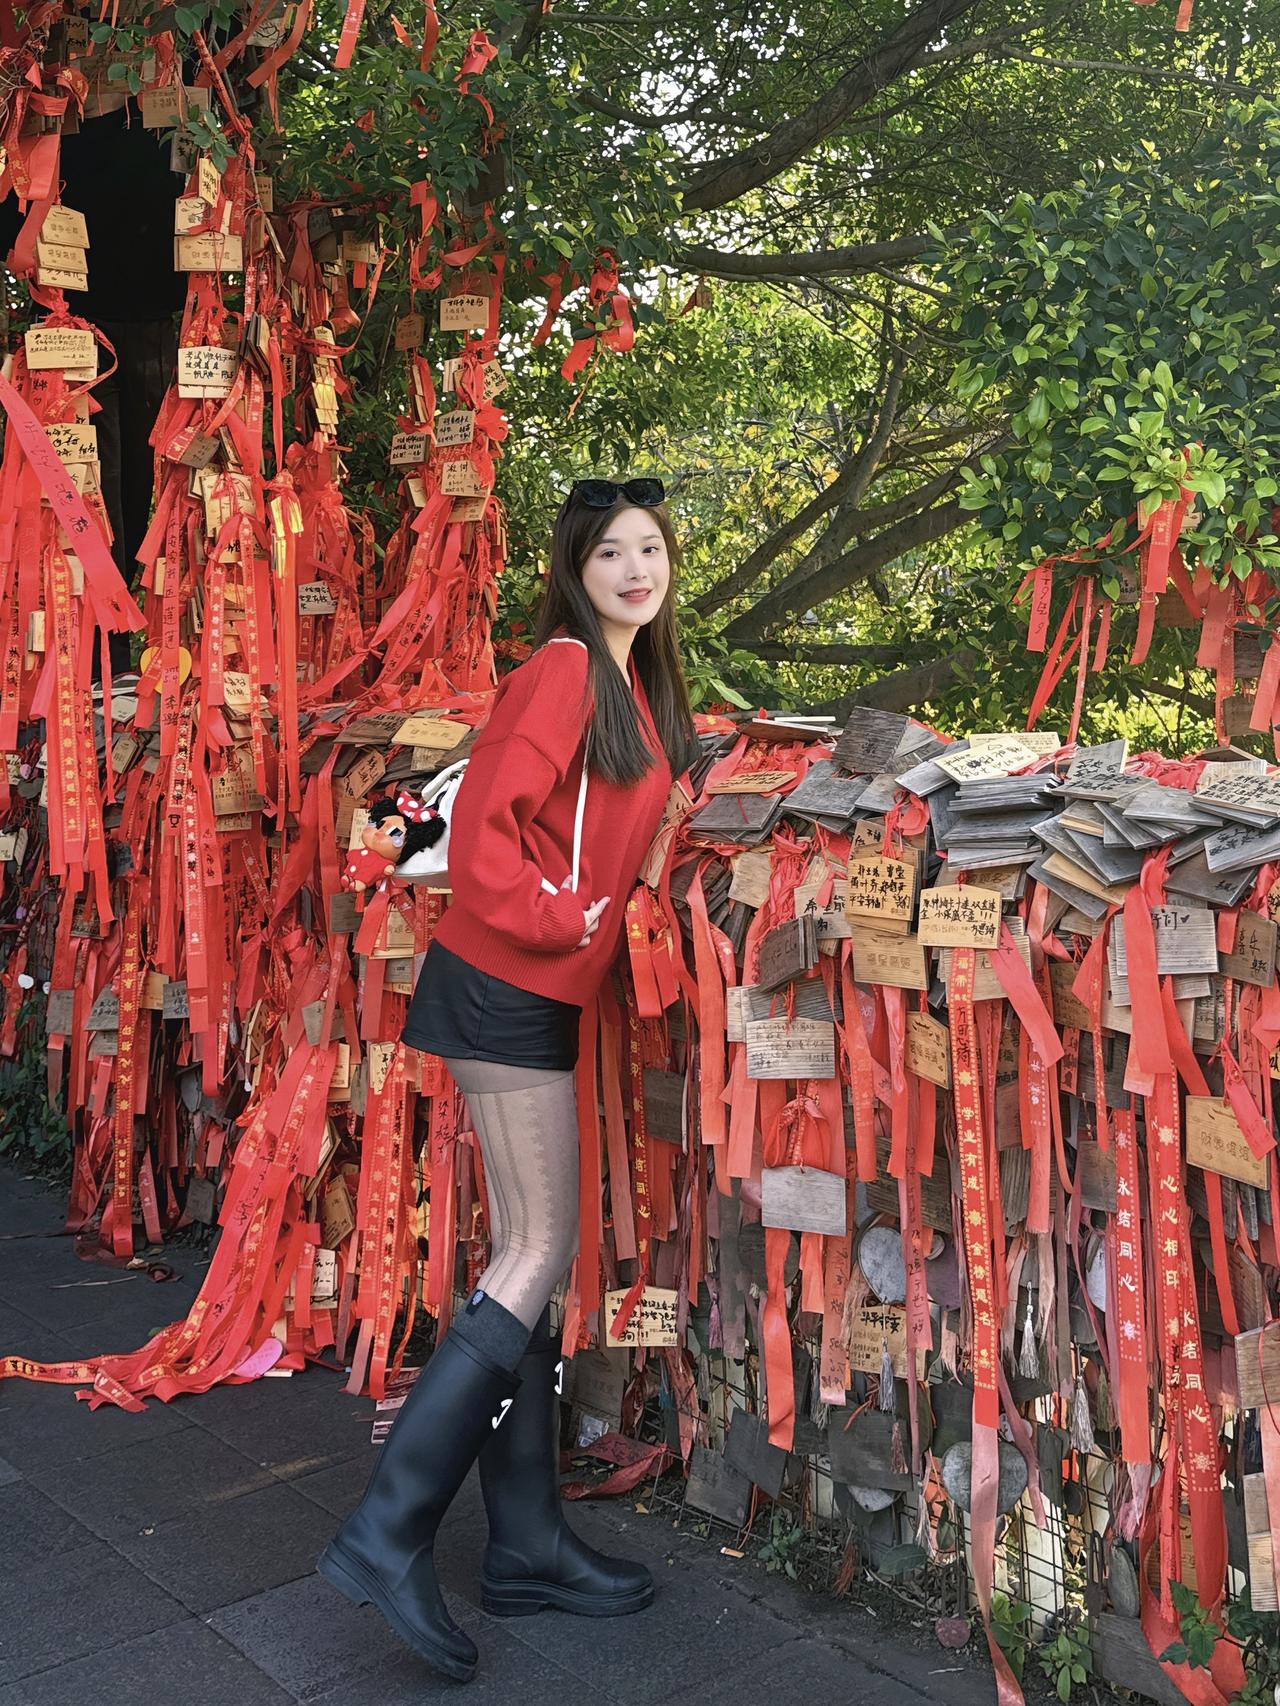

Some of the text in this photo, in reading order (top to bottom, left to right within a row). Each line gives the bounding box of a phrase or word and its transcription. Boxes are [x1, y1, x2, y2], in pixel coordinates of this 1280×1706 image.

[635, 1133, 650, 1218] 永结同心
[961, 1106, 980, 1191] 学业有成
[1117, 1176, 1136, 1292] 永结同心
[1160, 1174, 1180, 1289] 心心相印
[970, 1242, 992, 1326] 金榜题名
[1182, 1308, 1207, 1423] 永结同心
